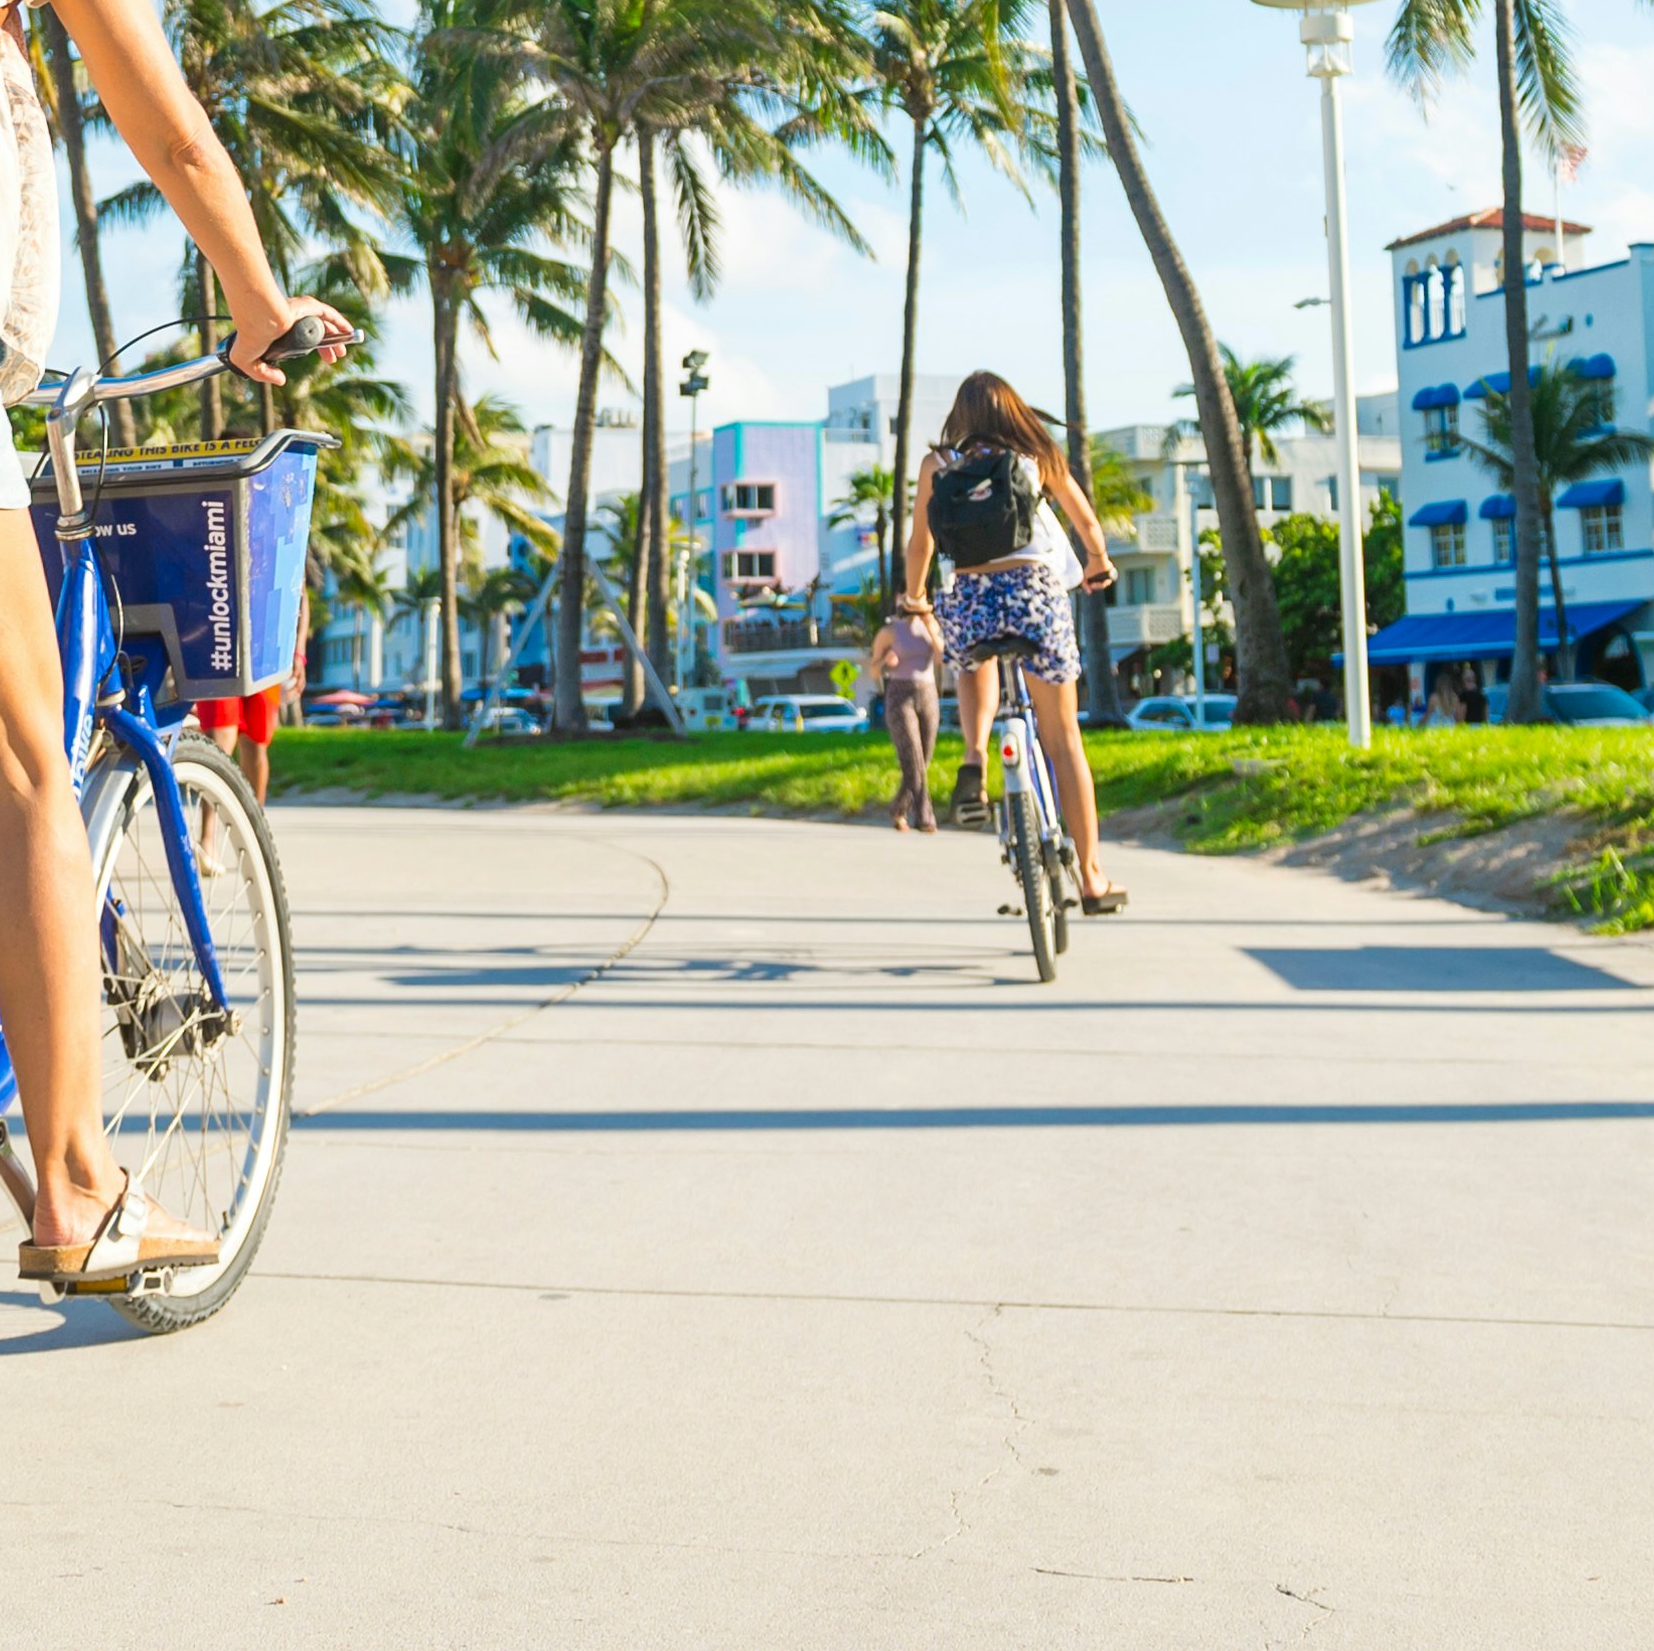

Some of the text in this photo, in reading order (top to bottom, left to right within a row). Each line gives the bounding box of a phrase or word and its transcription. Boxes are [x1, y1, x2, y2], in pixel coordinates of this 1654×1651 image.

[140, 445, 167, 456] THIS
[171, 443, 200, 454] BIKE
[205, 442, 216, 451] IS
[220, 441, 231, 450] A
[116, 523, 137, 536] us
[202, 501, 233, 671] #unlockmiami
